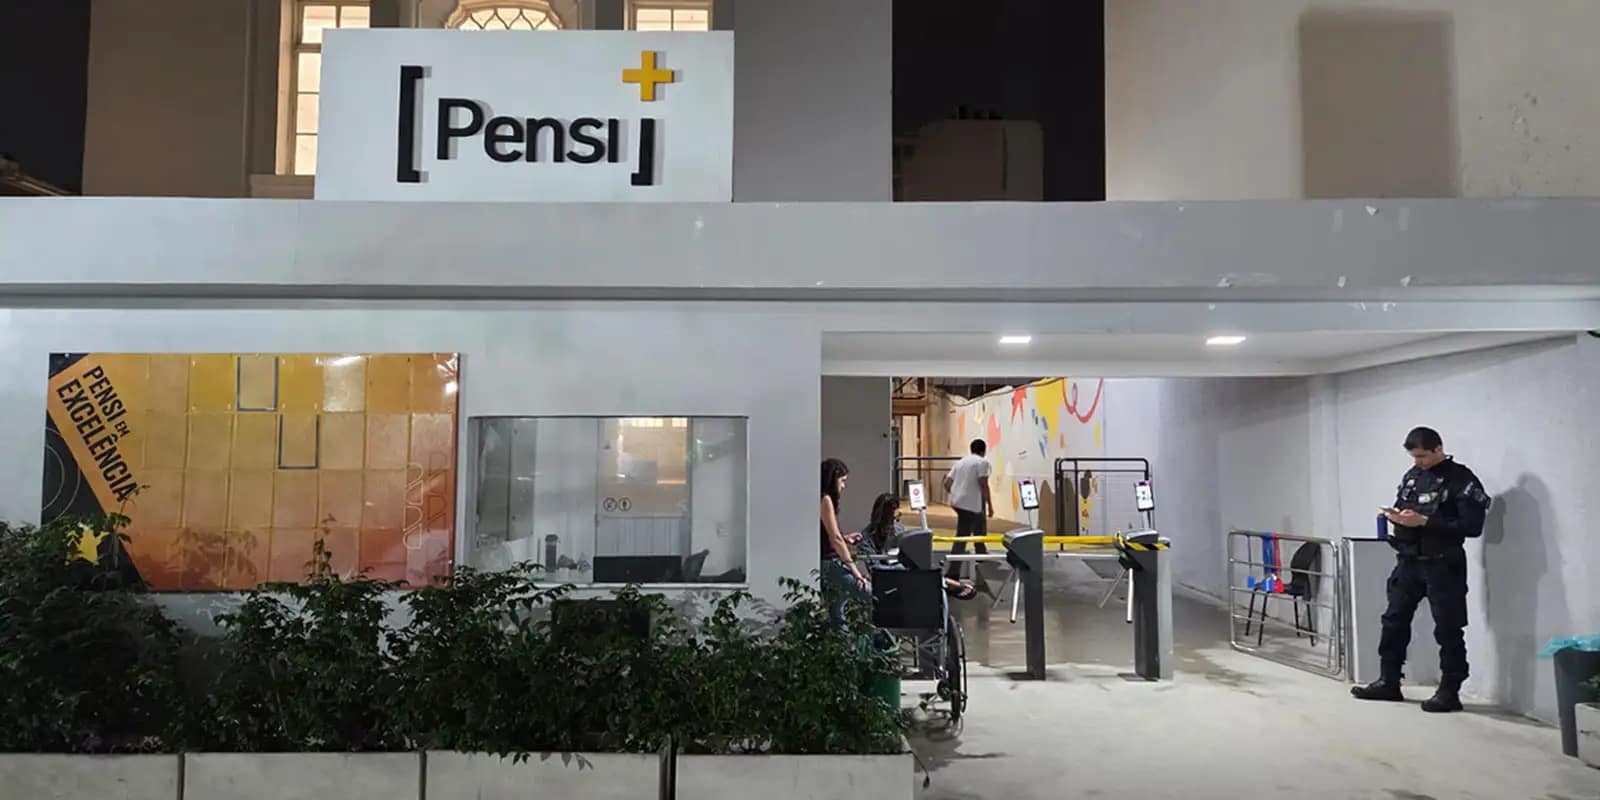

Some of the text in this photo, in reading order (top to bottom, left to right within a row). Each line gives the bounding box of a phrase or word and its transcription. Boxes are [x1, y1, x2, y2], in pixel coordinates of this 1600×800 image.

[56, 379, 138, 502] EXCELÊNCIA
[83, 366, 131, 437] PENSI EM
